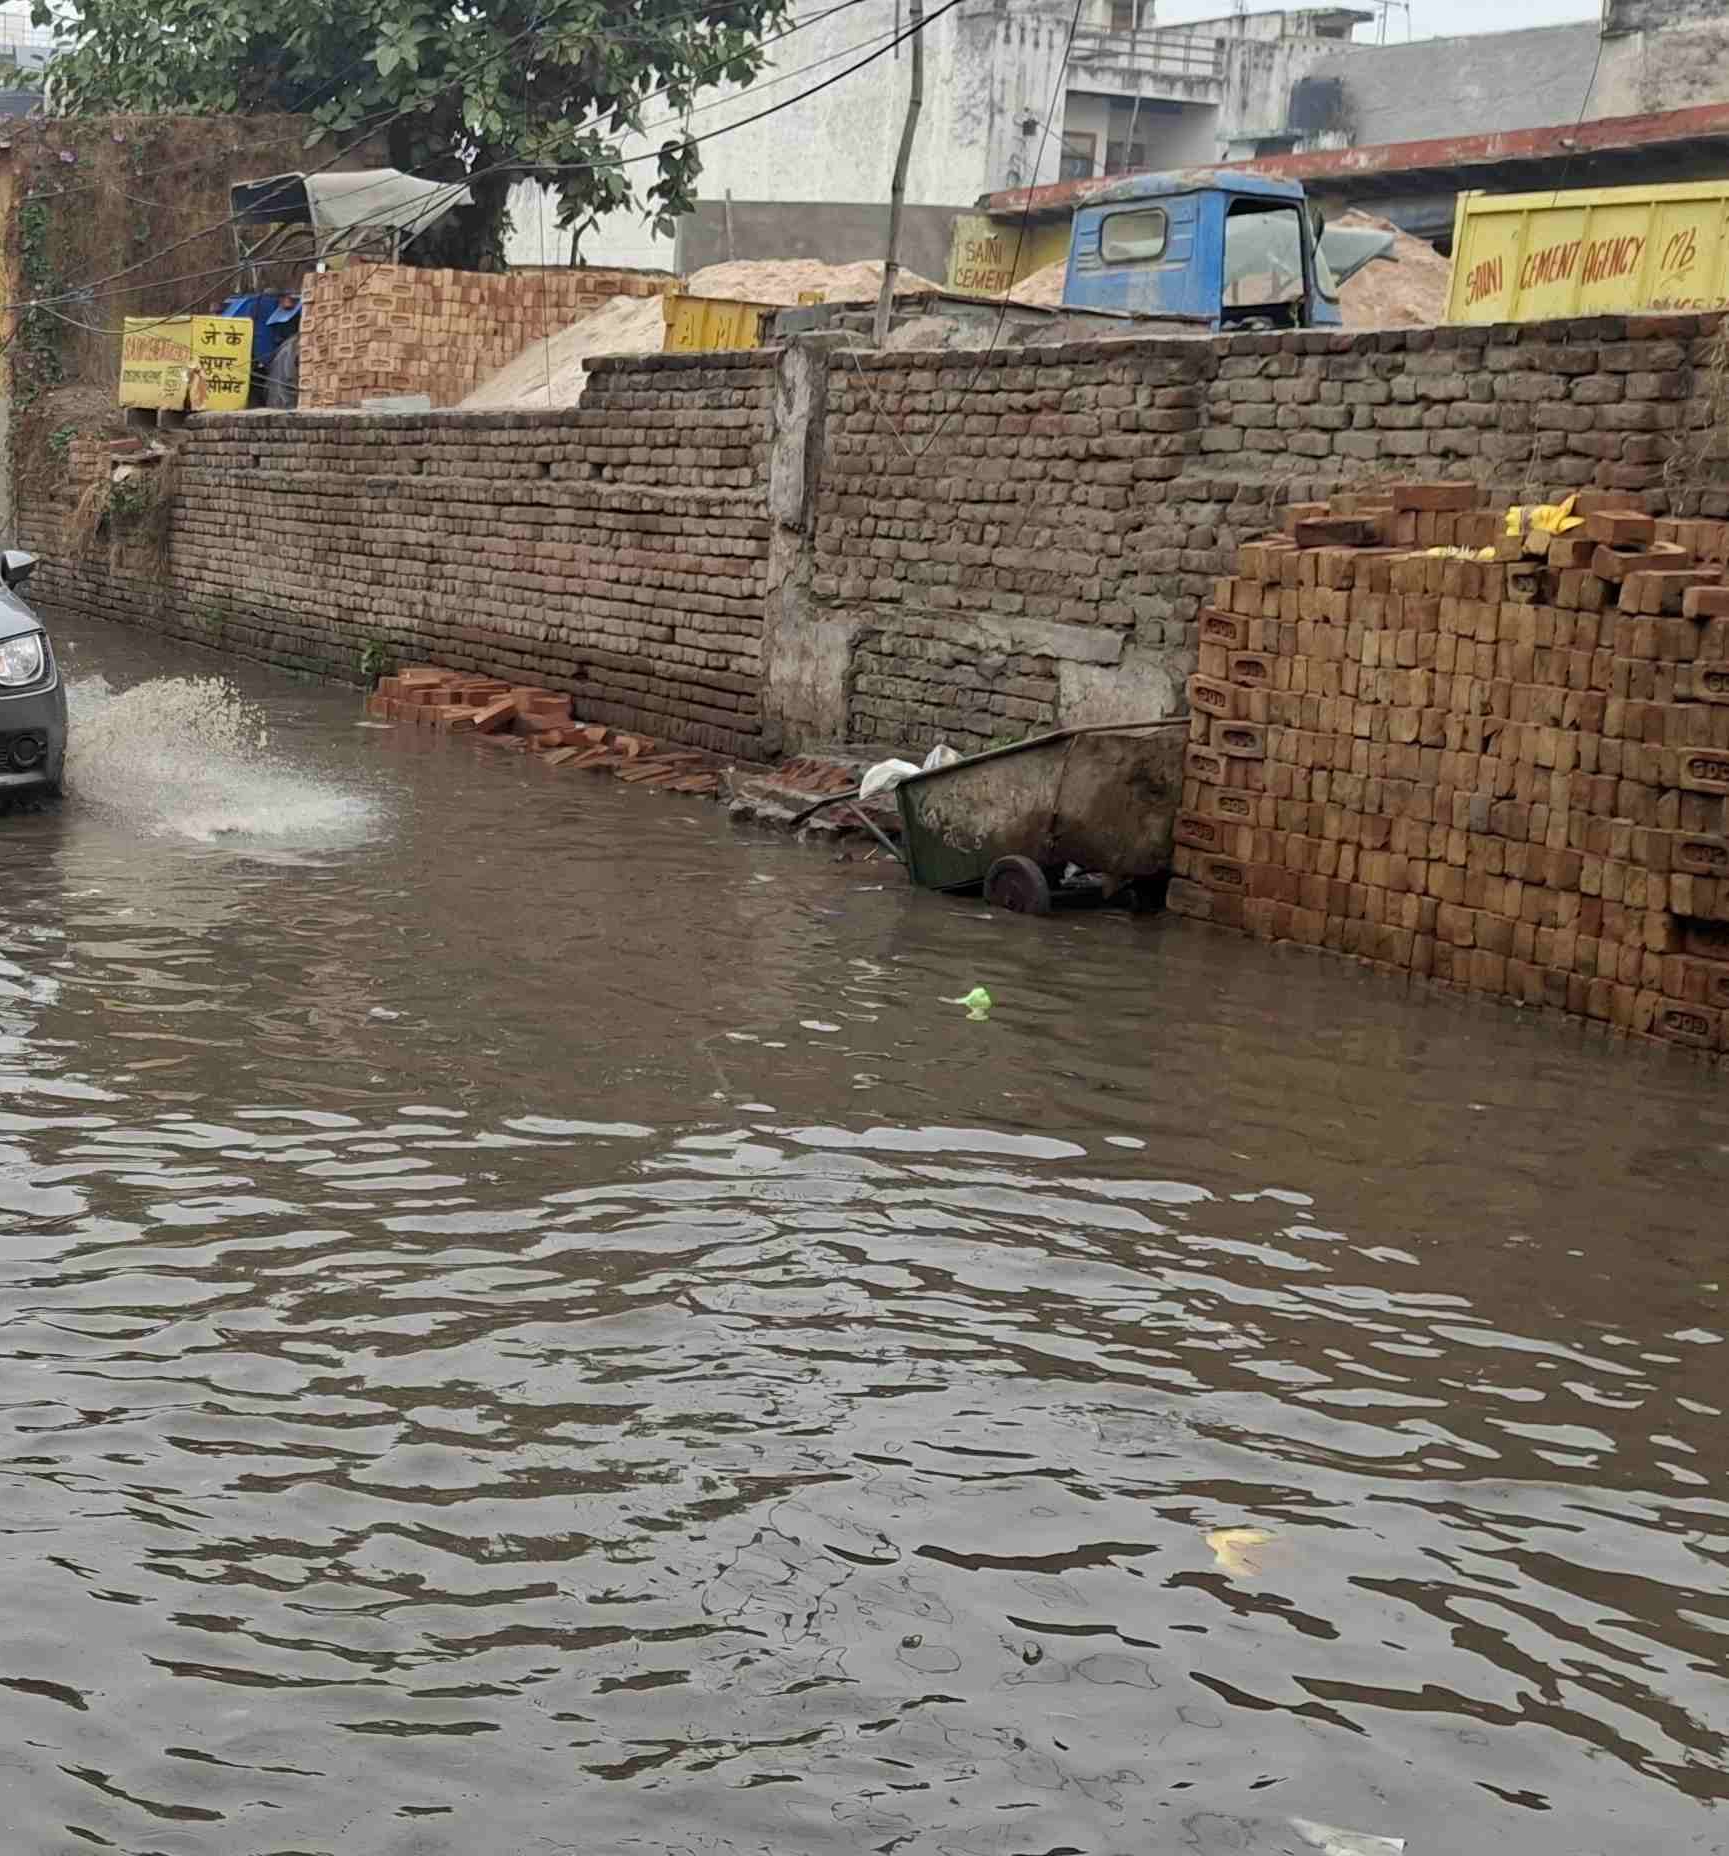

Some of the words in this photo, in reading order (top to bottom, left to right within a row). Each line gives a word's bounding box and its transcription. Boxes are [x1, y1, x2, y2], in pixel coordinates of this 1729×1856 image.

[965, 240, 1004, 265] SAINI
[1519, 241, 1582, 290] CEMENT
[1582, 235, 1646, 287] AGENCY
[201, 322, 221, 345] जे
[223, 325, 246, 346] के
